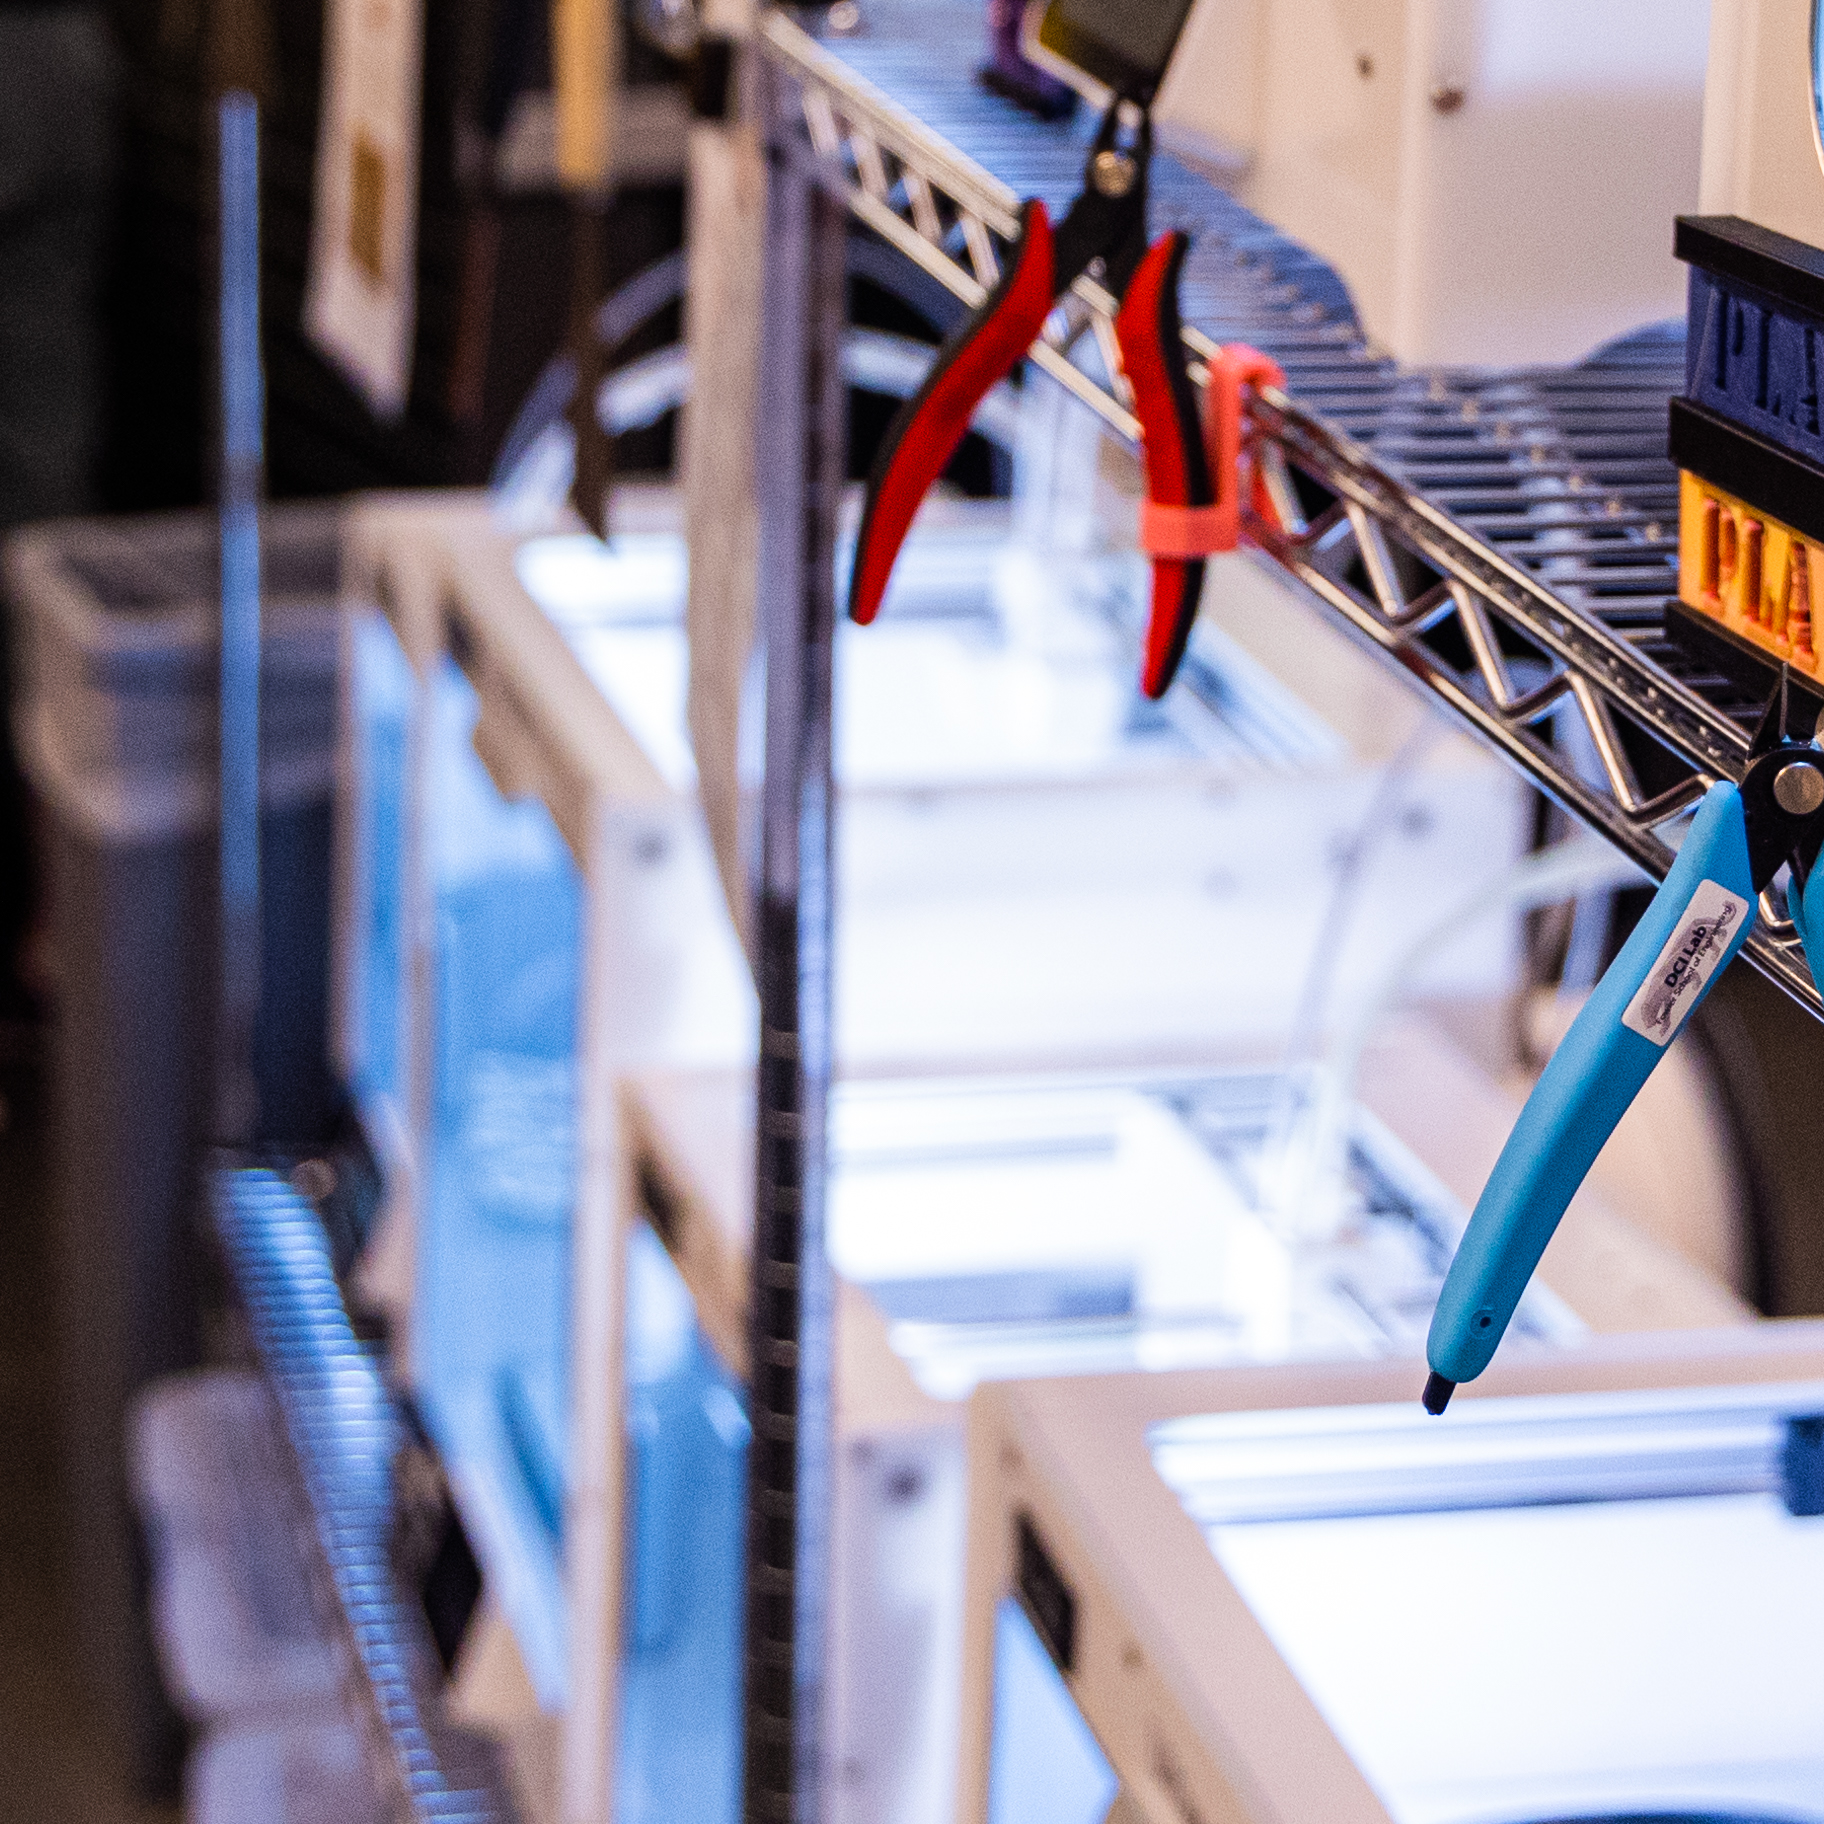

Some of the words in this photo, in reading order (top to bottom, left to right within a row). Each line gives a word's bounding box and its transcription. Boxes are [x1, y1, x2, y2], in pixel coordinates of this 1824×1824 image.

[1701, 498, 1818, 670] PLA
[1664, 957, 1690, 988] DCI
[1684, 925, 1708, 958] Lab
[1673, 966, 1695, 996] School
[1692, 956, 1701, 967] of
[1698, 904, 1733, 957] Engineering
